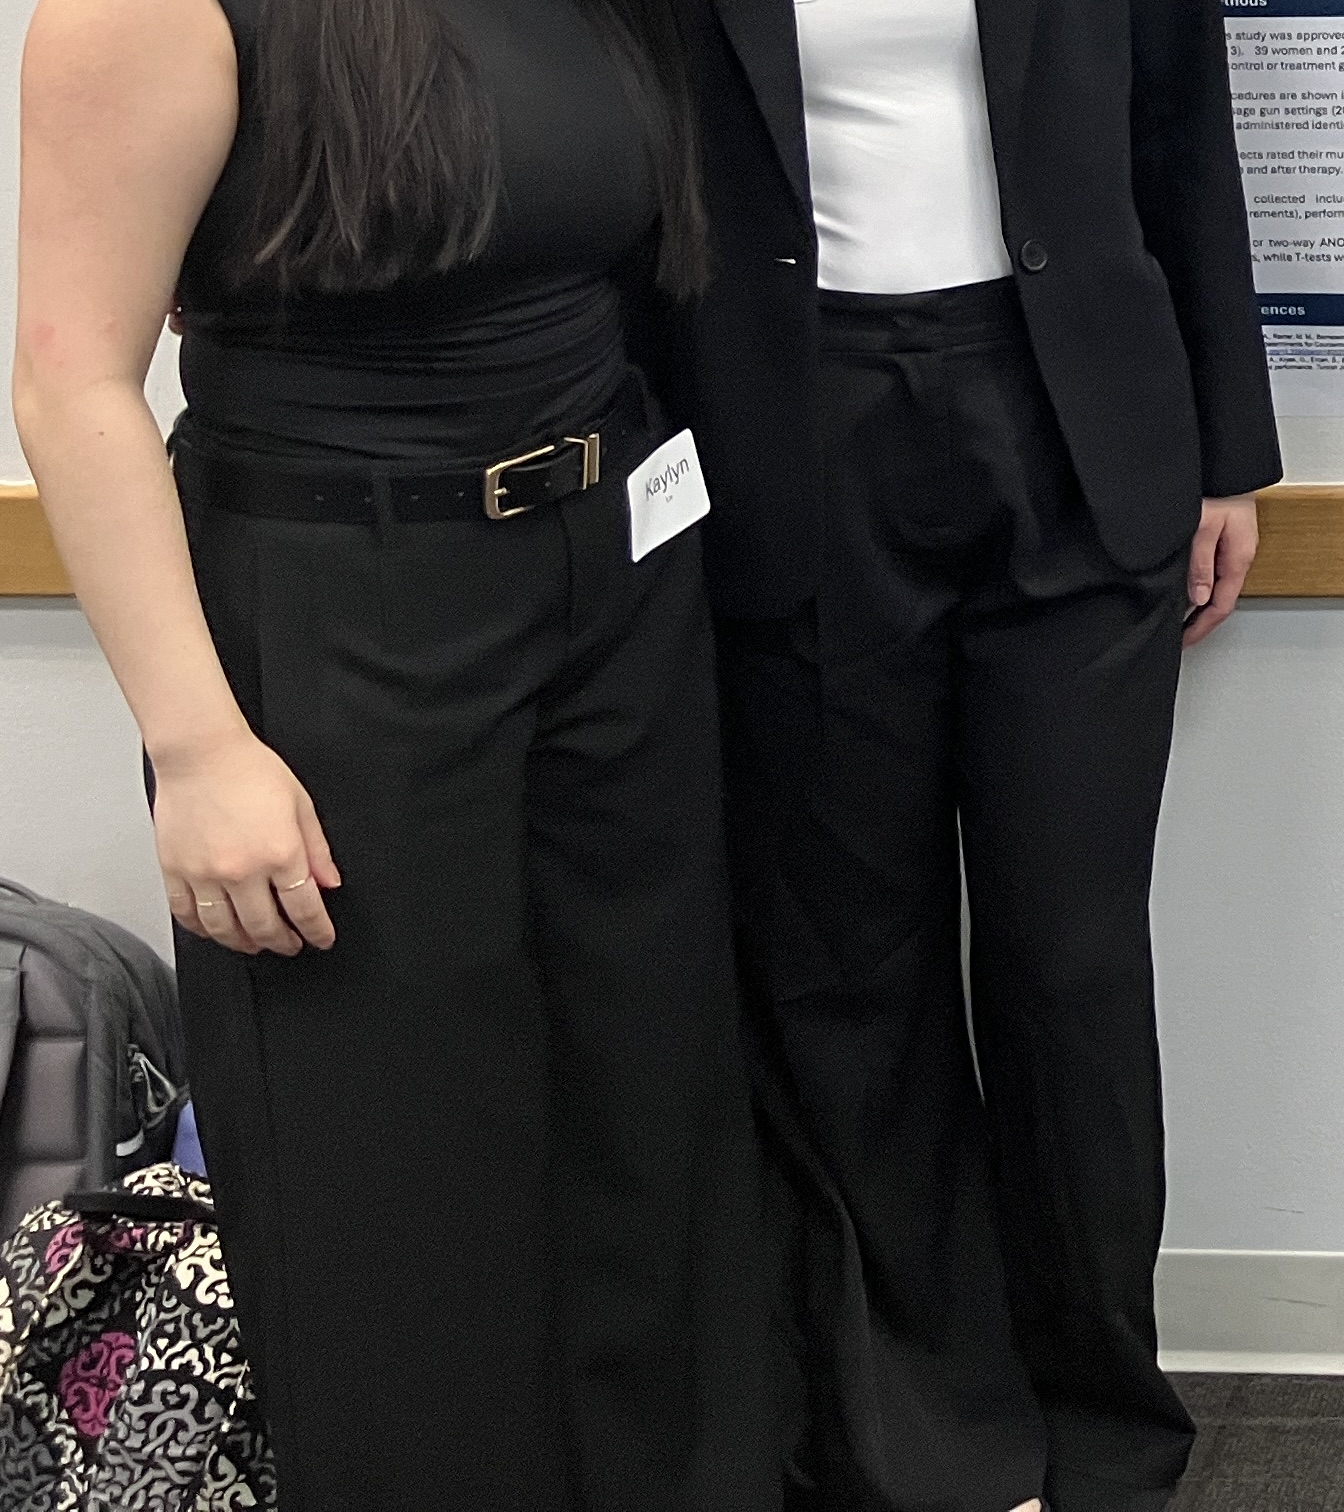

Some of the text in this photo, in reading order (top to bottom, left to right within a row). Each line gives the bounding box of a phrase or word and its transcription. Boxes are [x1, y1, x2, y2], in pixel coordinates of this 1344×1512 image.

[1253, 193, 1305, 204] collected
[1260, 306, 1305, 315] ences
[645, 457, 690, 502] Kaylyn
